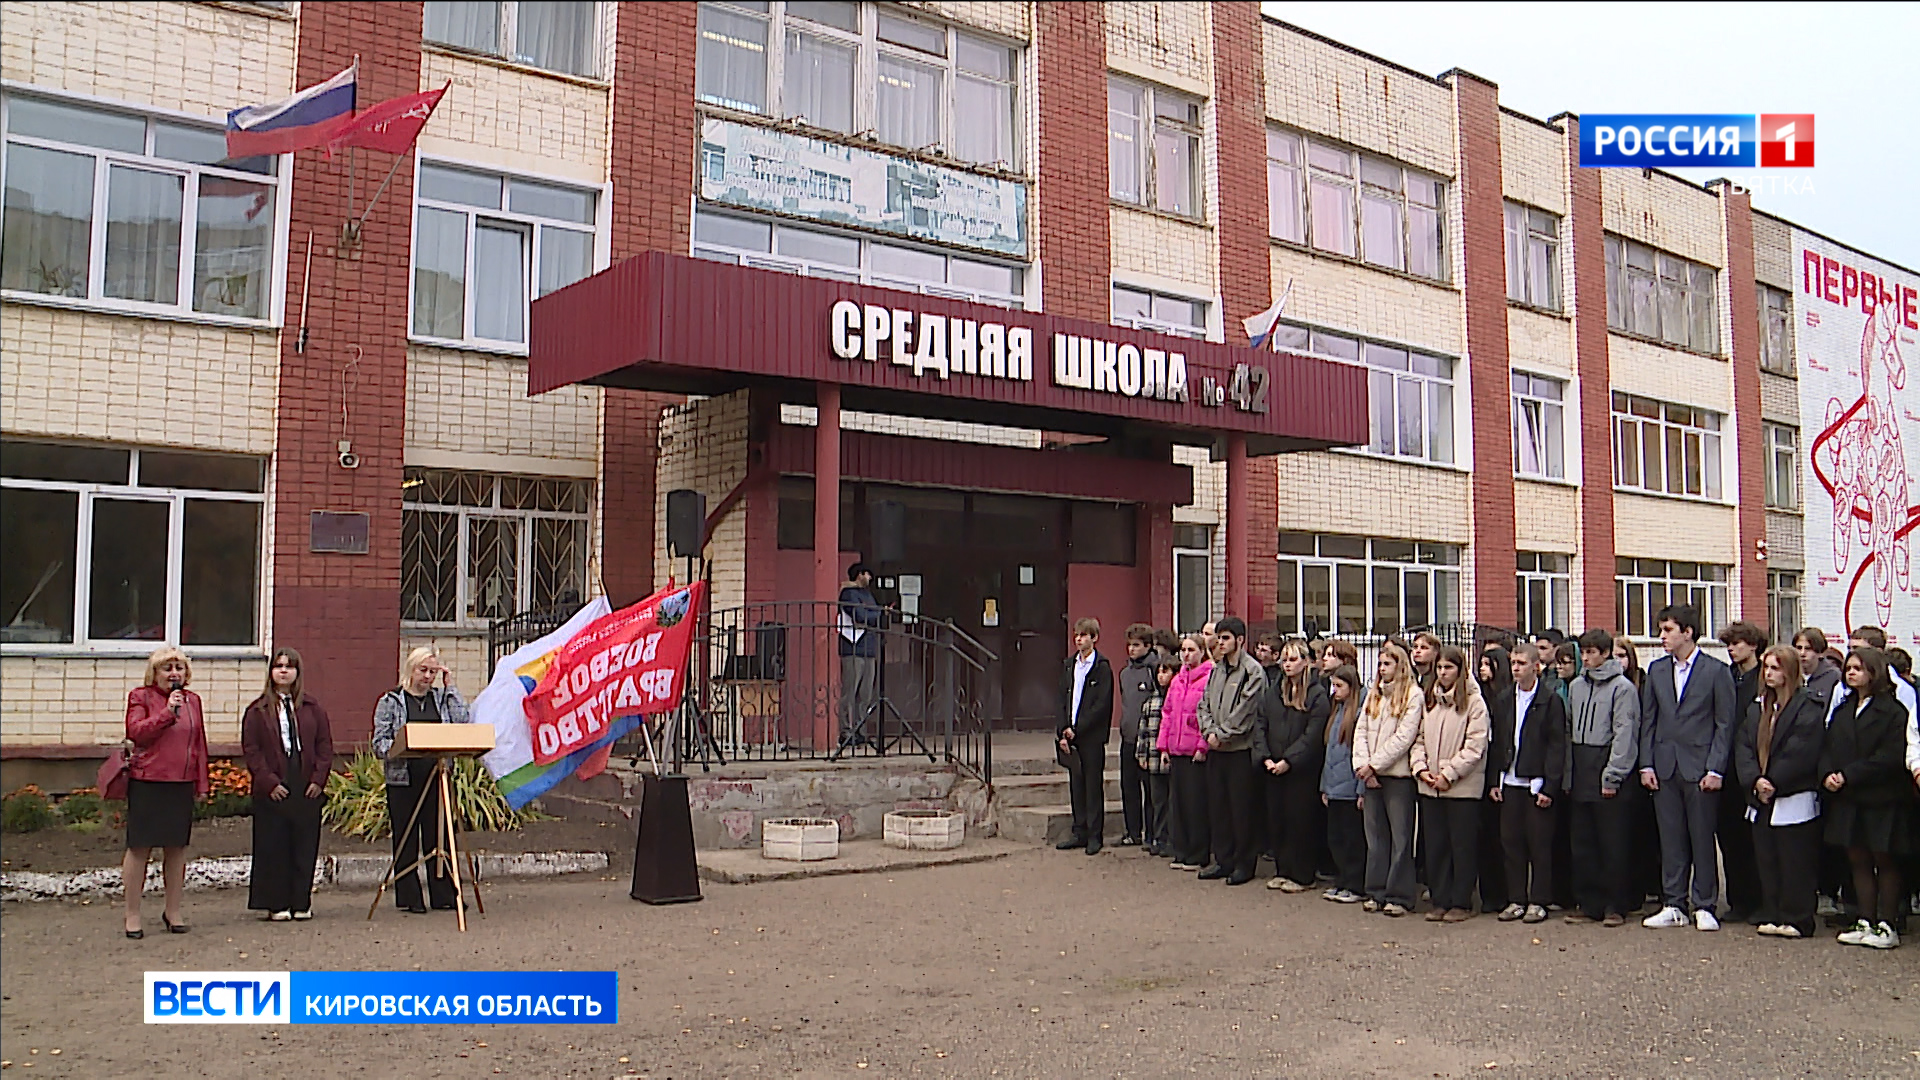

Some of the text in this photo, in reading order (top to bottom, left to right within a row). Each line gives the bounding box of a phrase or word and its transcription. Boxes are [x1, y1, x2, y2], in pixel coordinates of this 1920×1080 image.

[1803, 249, 1919, 330] ПЕРВЫЕ
[830, 300, 1033, 380] СРЕДНЯЯ
[1053, 332, 1190, 403] ШКОЛА
[1229, 363, 1270, 414] 42
